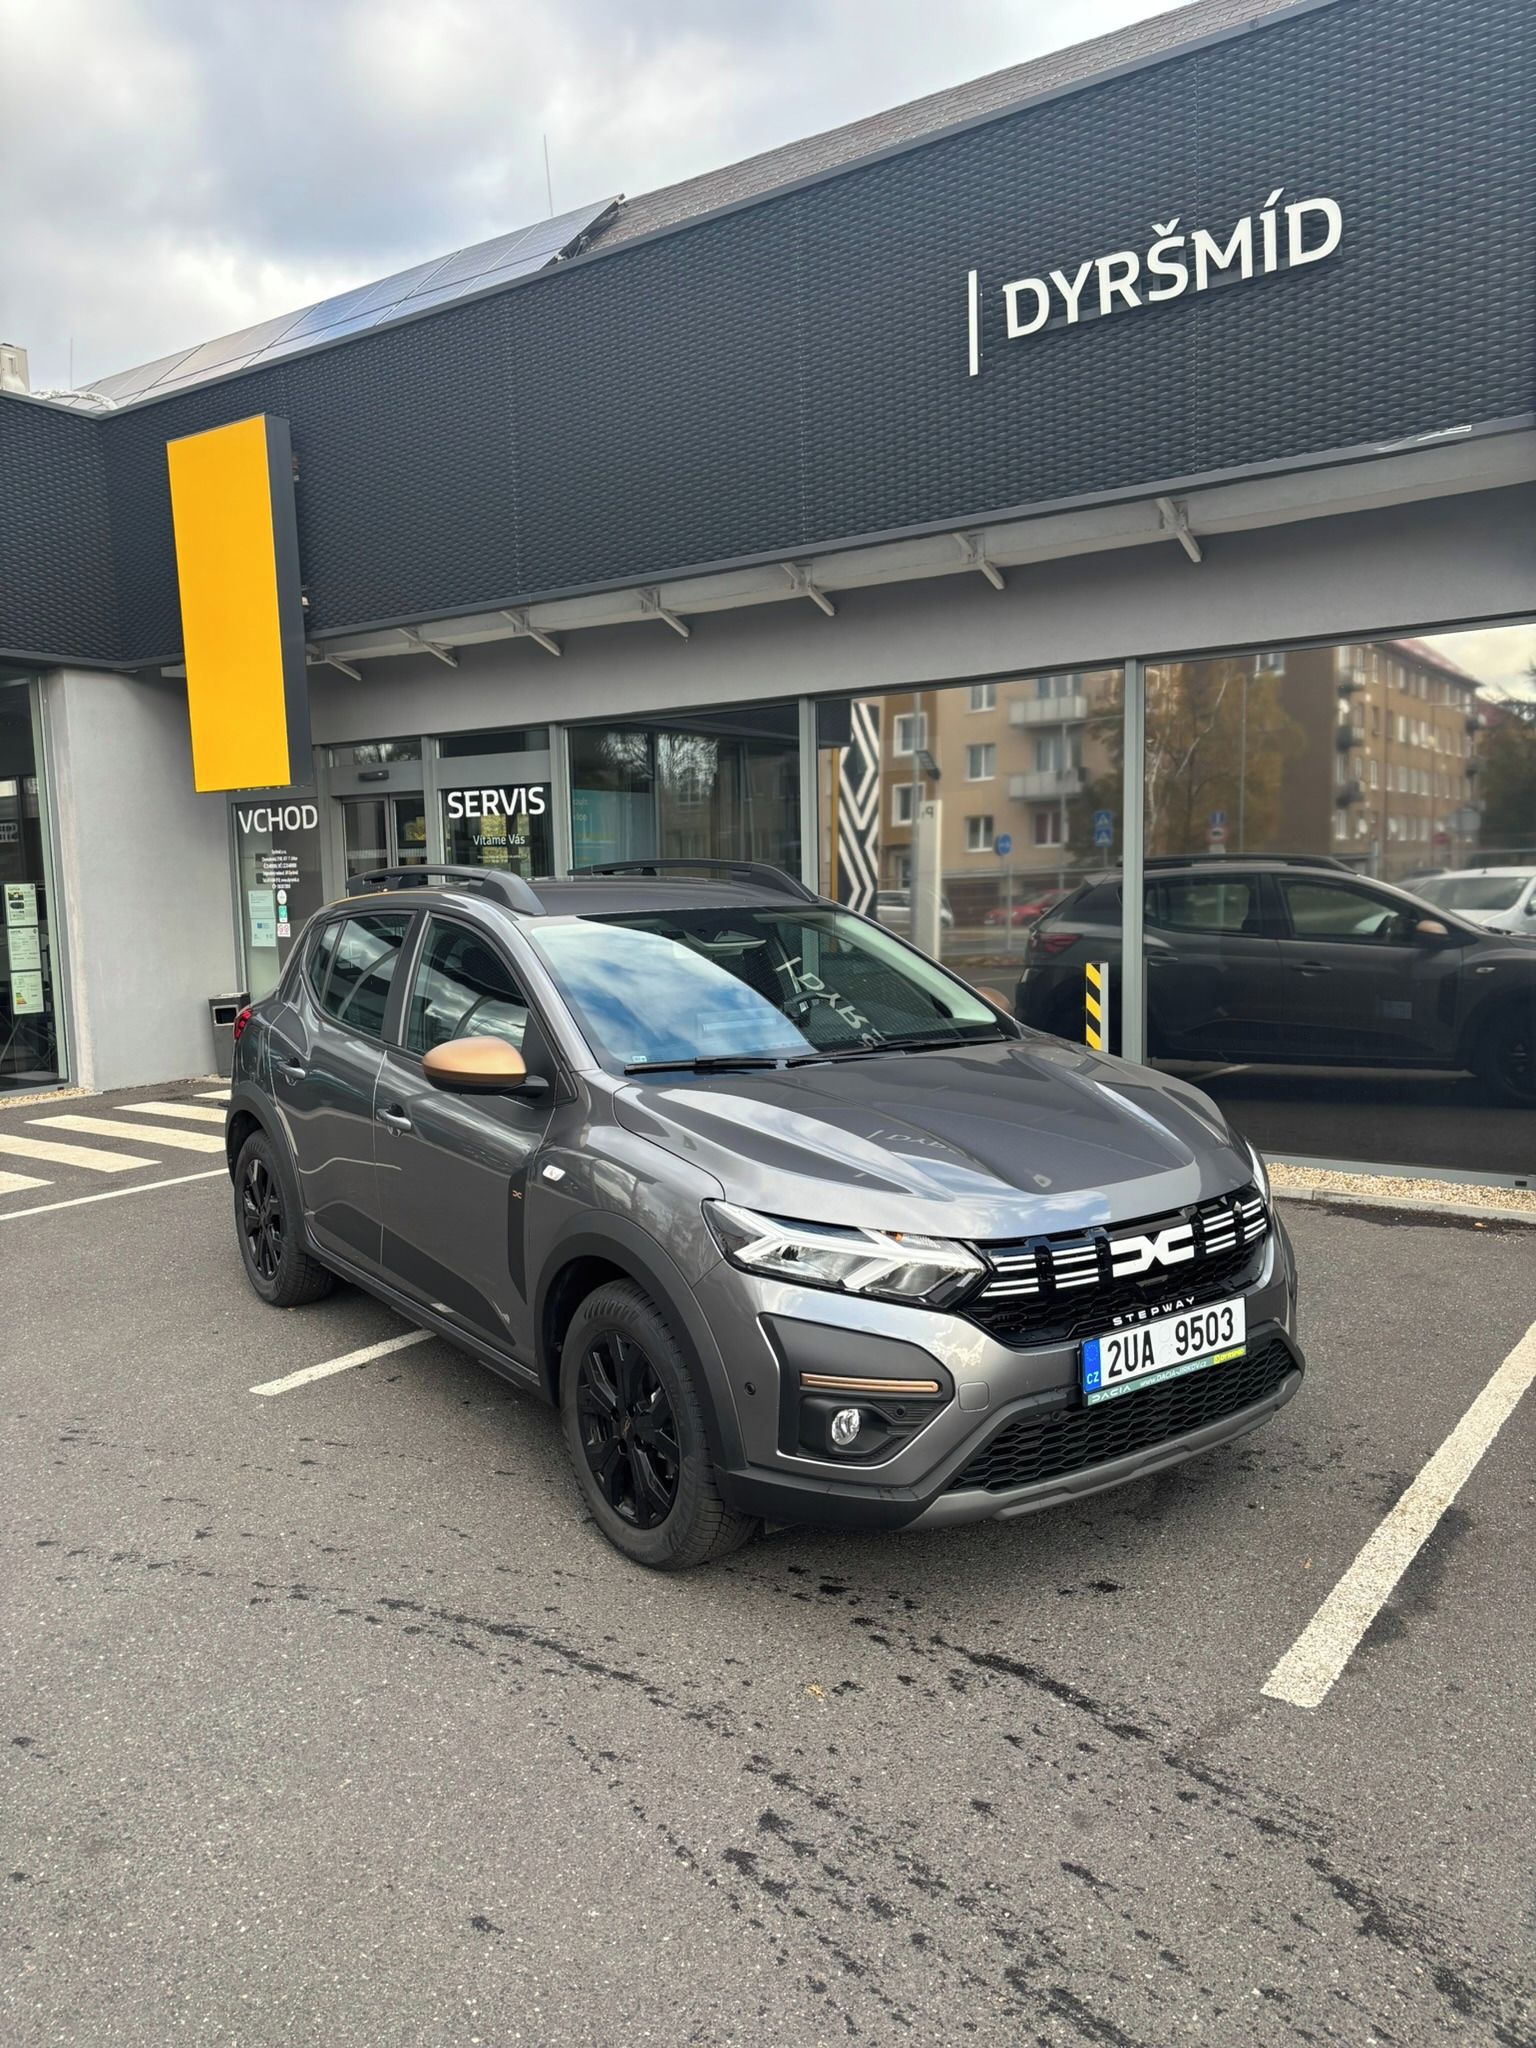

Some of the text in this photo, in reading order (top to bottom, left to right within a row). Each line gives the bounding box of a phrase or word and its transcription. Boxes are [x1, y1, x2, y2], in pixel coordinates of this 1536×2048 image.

[1001, 187, 1343, 339] DYRŠMÍD
[447, 786, 546, 819] SERVIS
[238, 804, 318, 834] VCHOD
[508, 833, 526, 845] Vás
[1112, 1296, 1195, 1327] STEPWAY
[1107, 1306, 1233, 1378] 2UA 9503
[1086, 1370, 1100, 1385] CZ
[1091, 1385, 1132, 1404] DACIA
